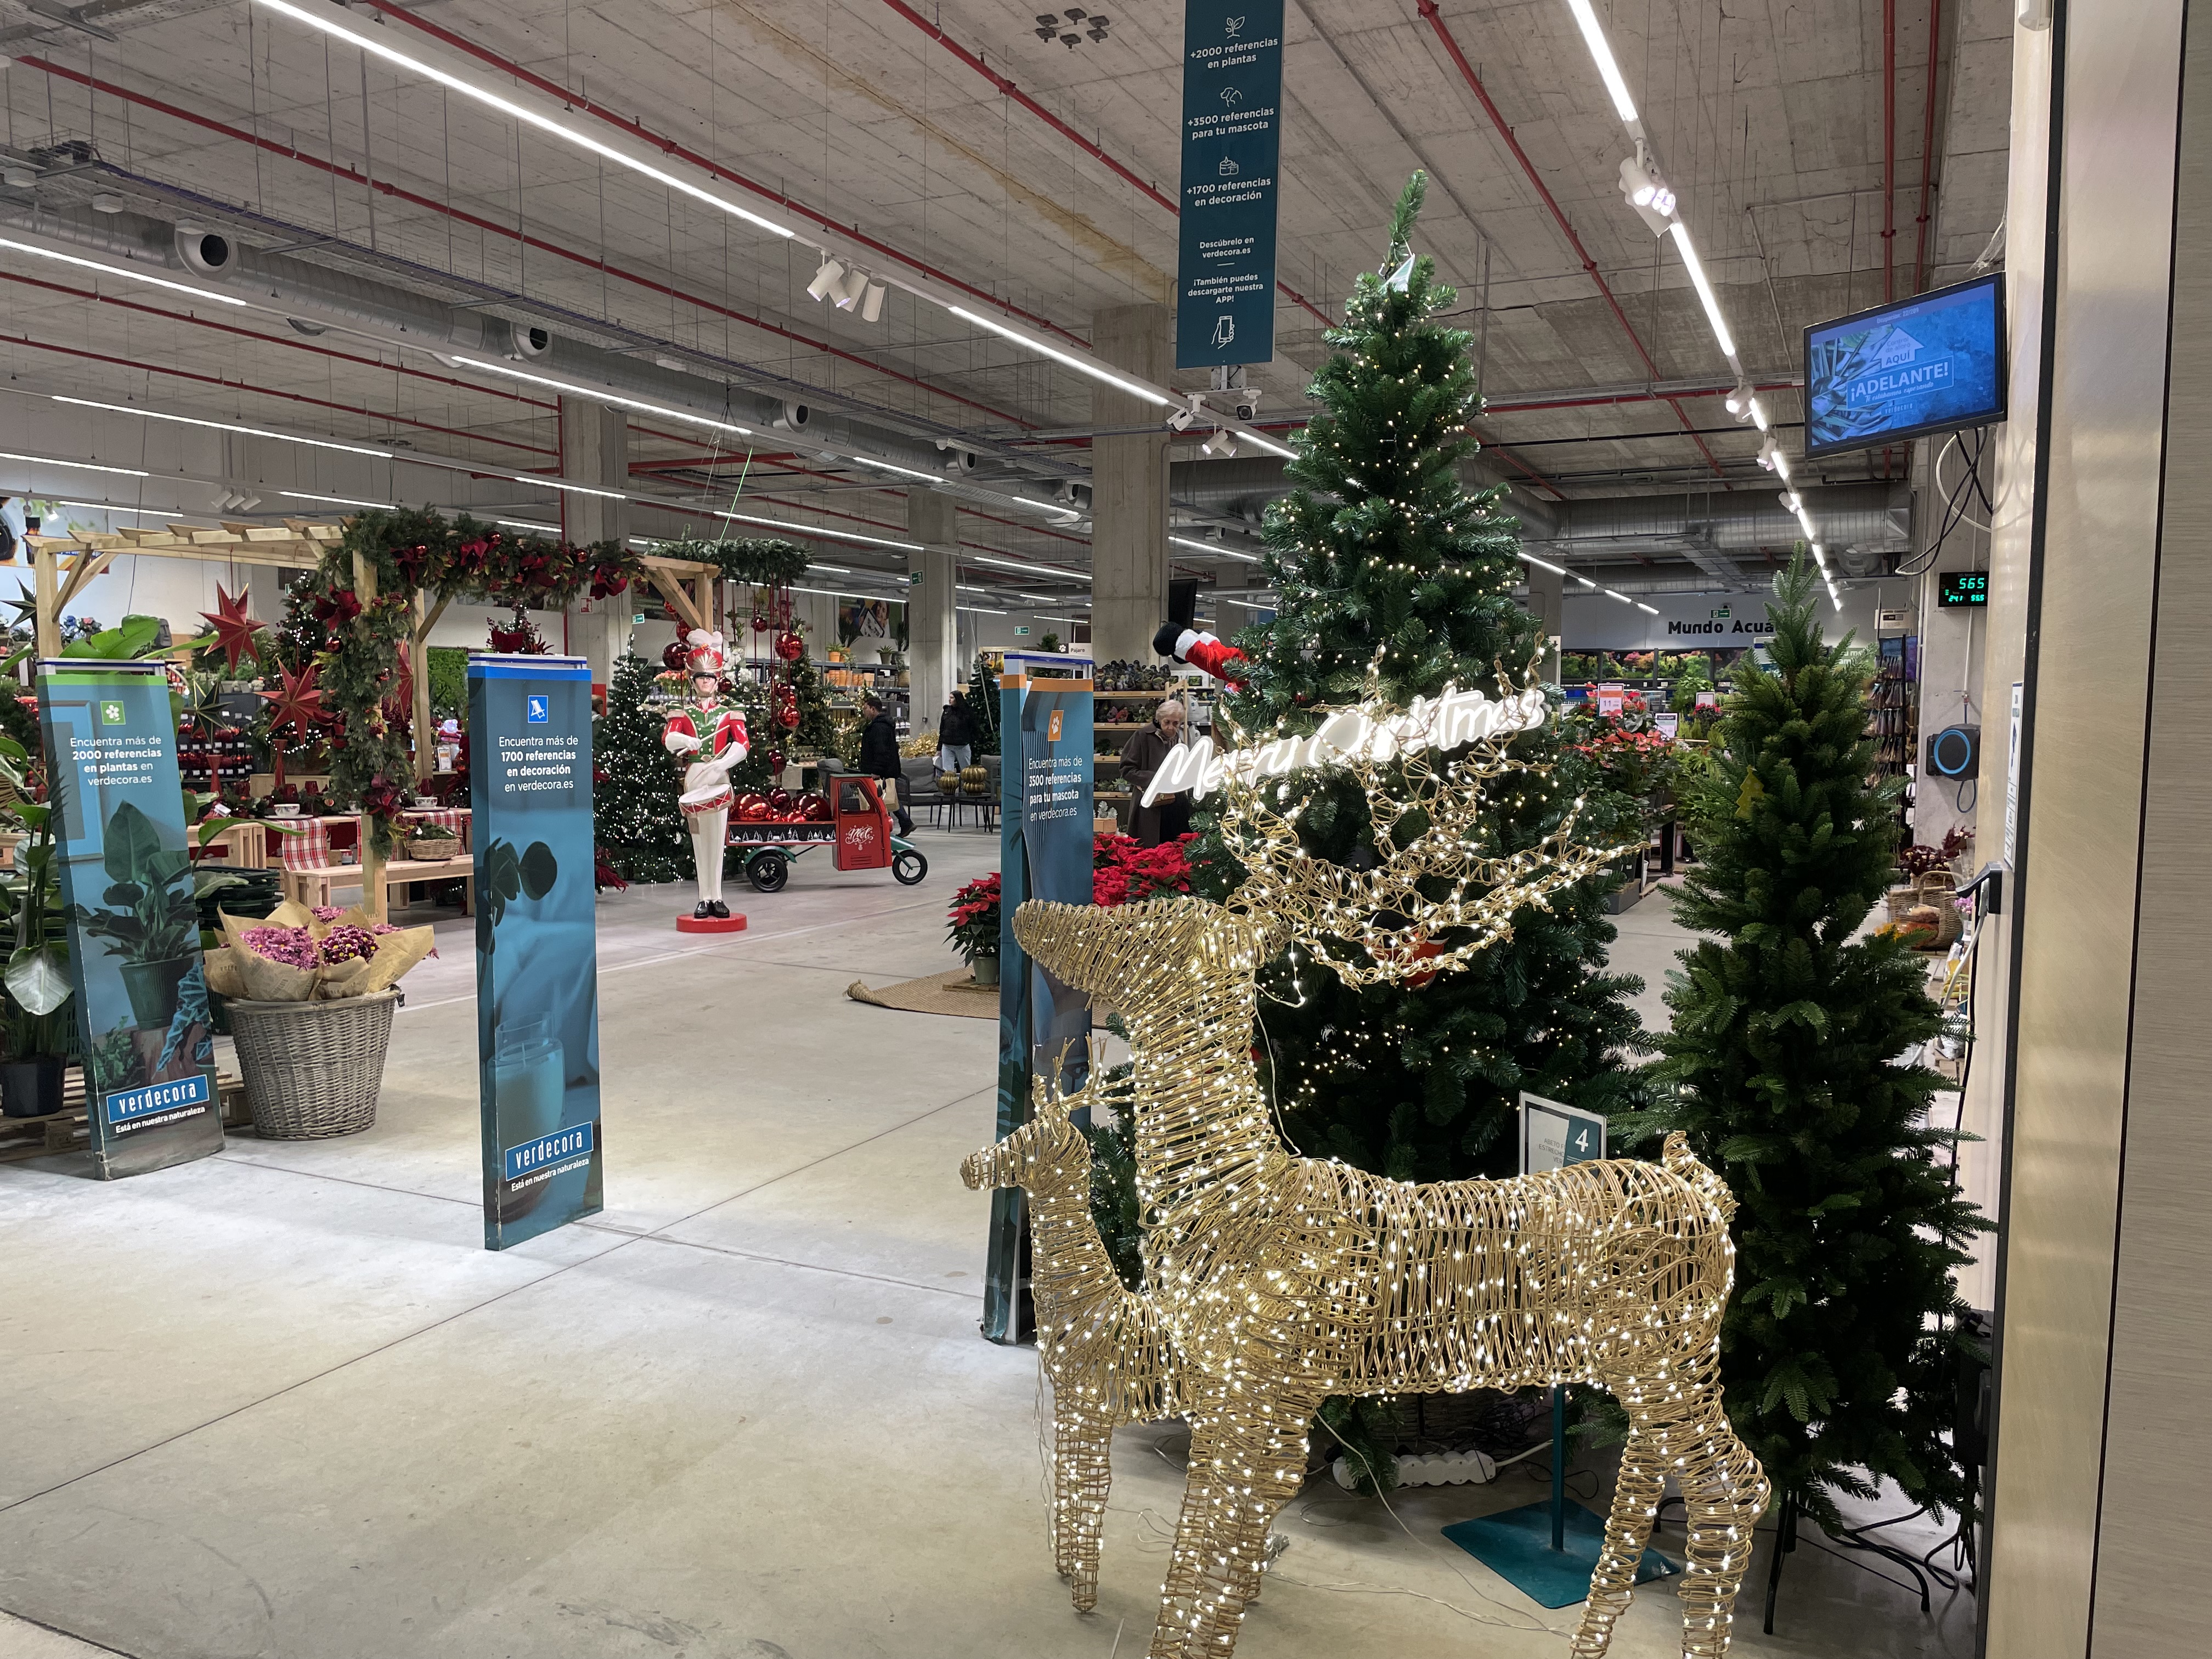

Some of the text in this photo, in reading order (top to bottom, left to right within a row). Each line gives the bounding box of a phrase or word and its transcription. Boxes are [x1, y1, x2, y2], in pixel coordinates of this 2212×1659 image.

[1190, 38, 1278, 58] +2000 referencias
[1207, 54, 1256, 69] en plantas
[1188, 108, 1274, 127] +3500 referencias
[1192, 121, 1268, 140] para tu mascota
[1187, 177, 1271, 195] +1700 referencias
[1195, 190, 1262, 207] en decoración
[1199, 237, 1242, 249] Descúbrelo
[1203, 247, 1251, 258] verdecora.es
[1193, 273, 1258, 286] ¡También puedes
[1188, 283, 1263, 297] descargarte nuestra
[1216, 295, 1234, 303] APP!
[1887, 336, 1909, 347] Control
[1886, 349, 1909, 365] AQUÍ
[1851, 362, 1948, 402] ¡ADELANTE!
[1959, 578, 1984, 589] 565
[1668, 618, 1774, 634] Mundo Acuá
[70, 735, 161, 747] Encuentra más de
[499, 735, 578, 747] Encuentra más de
[72, 748, 162, 760] 2000 referencias
[501, 750, 576, 762] 1700 referencias
[84, 764, 97, 772] en
[100, 763, 138, 774] plantas
[1029, 755, 1082, 770] Encuentra más de
[506, 764, 571, 777] en decoración
[88, 775, 153, 786] verdecora.es
[505, 780, 573, 792] en verdecora.es
[1029, 771, 1081, 787] 3500 referencias
[1030, 789, 1079, 806] para tu mascota
[1030, 806, 1077, 821] en verdecora.es
[119, 1083, 196, 1114] verdecora
[115, 1124, 131, 1133] Está
[142, 1115, 168, 1127] nuestra
[169, 1107, 206, 1120] naturaleza
[1544, 1138, 1560, 1148] ABETO
[1575, 1128, 1589, 1153] 4
[516, 1131, 583, 1169] verdecora
[511, 1158, 589, 1192] Está en nuestra naturaleza
